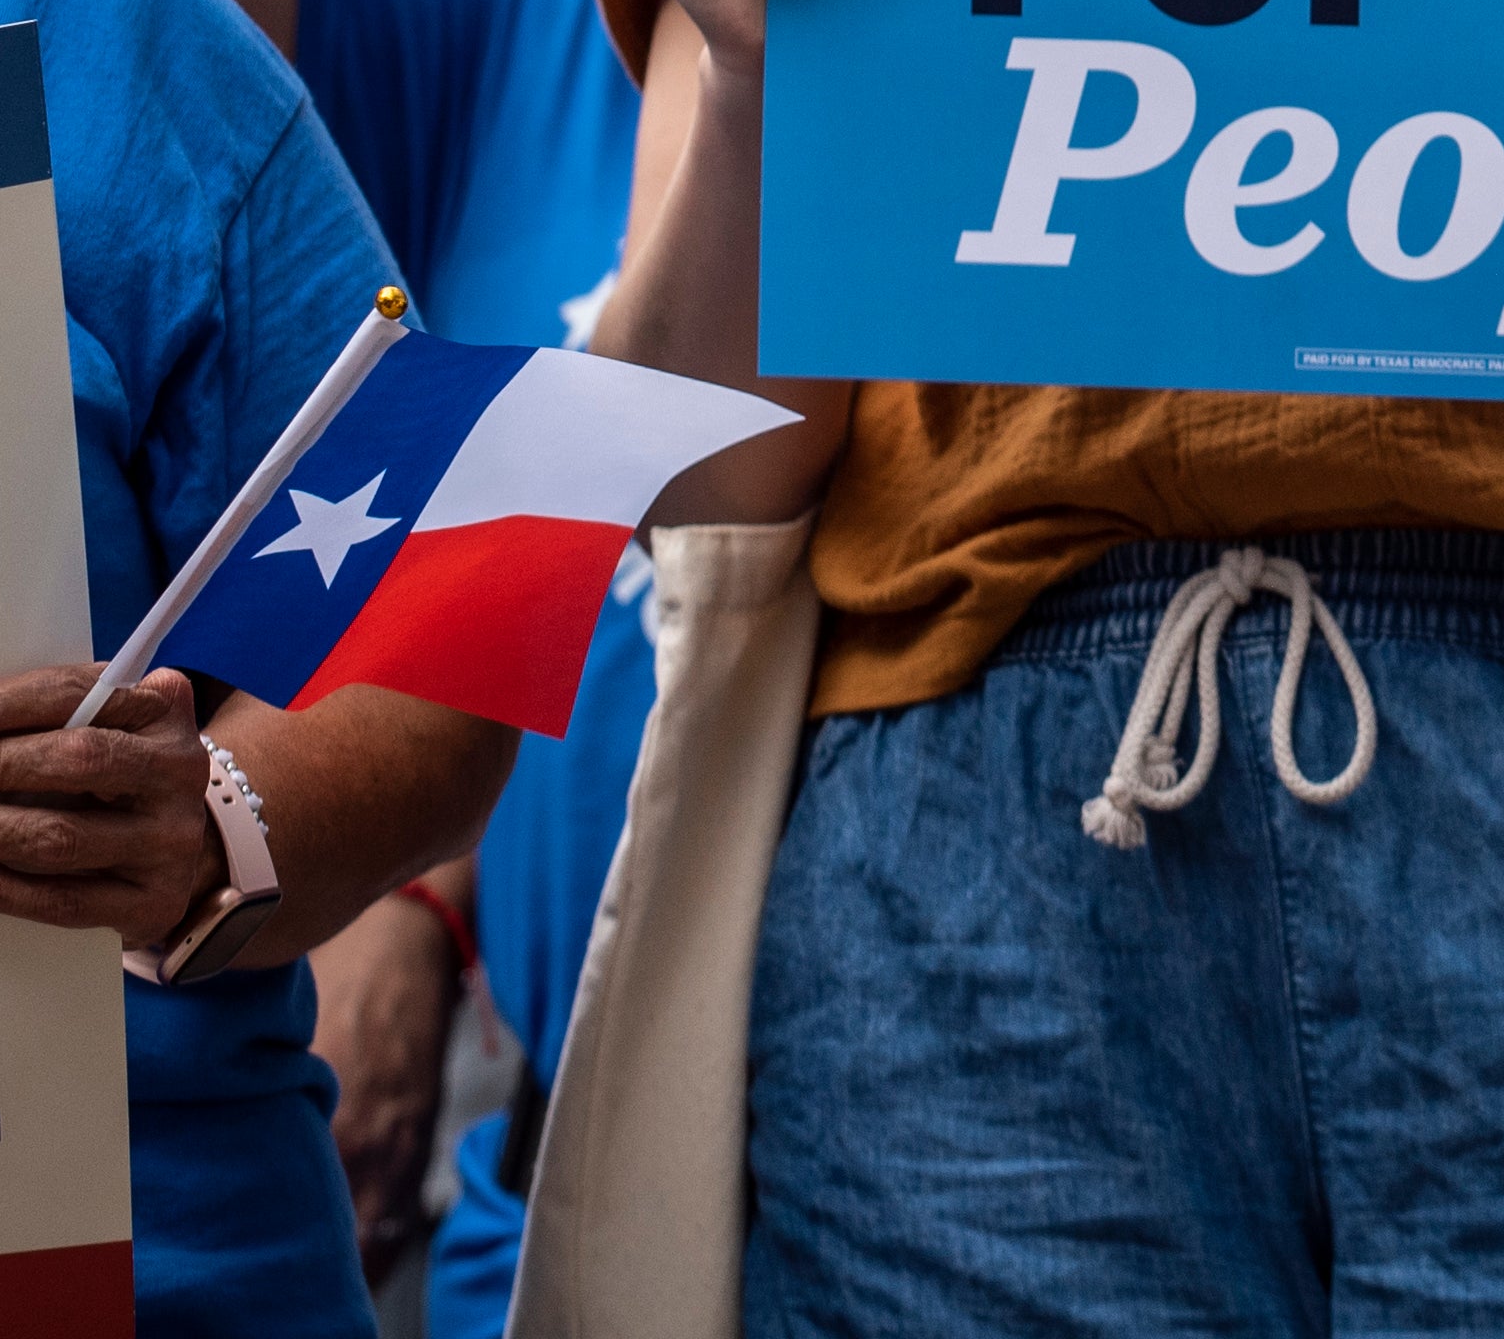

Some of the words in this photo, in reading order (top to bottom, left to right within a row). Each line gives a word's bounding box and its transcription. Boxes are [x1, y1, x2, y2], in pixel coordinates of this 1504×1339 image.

[1303, 354, 1329, 366] PAID
[1331, 355, 1355, 366] FOR
[1375, 356, 1410, 368] TEXAS
[1413, 357, 1486, 371] DEMOCRATIC
